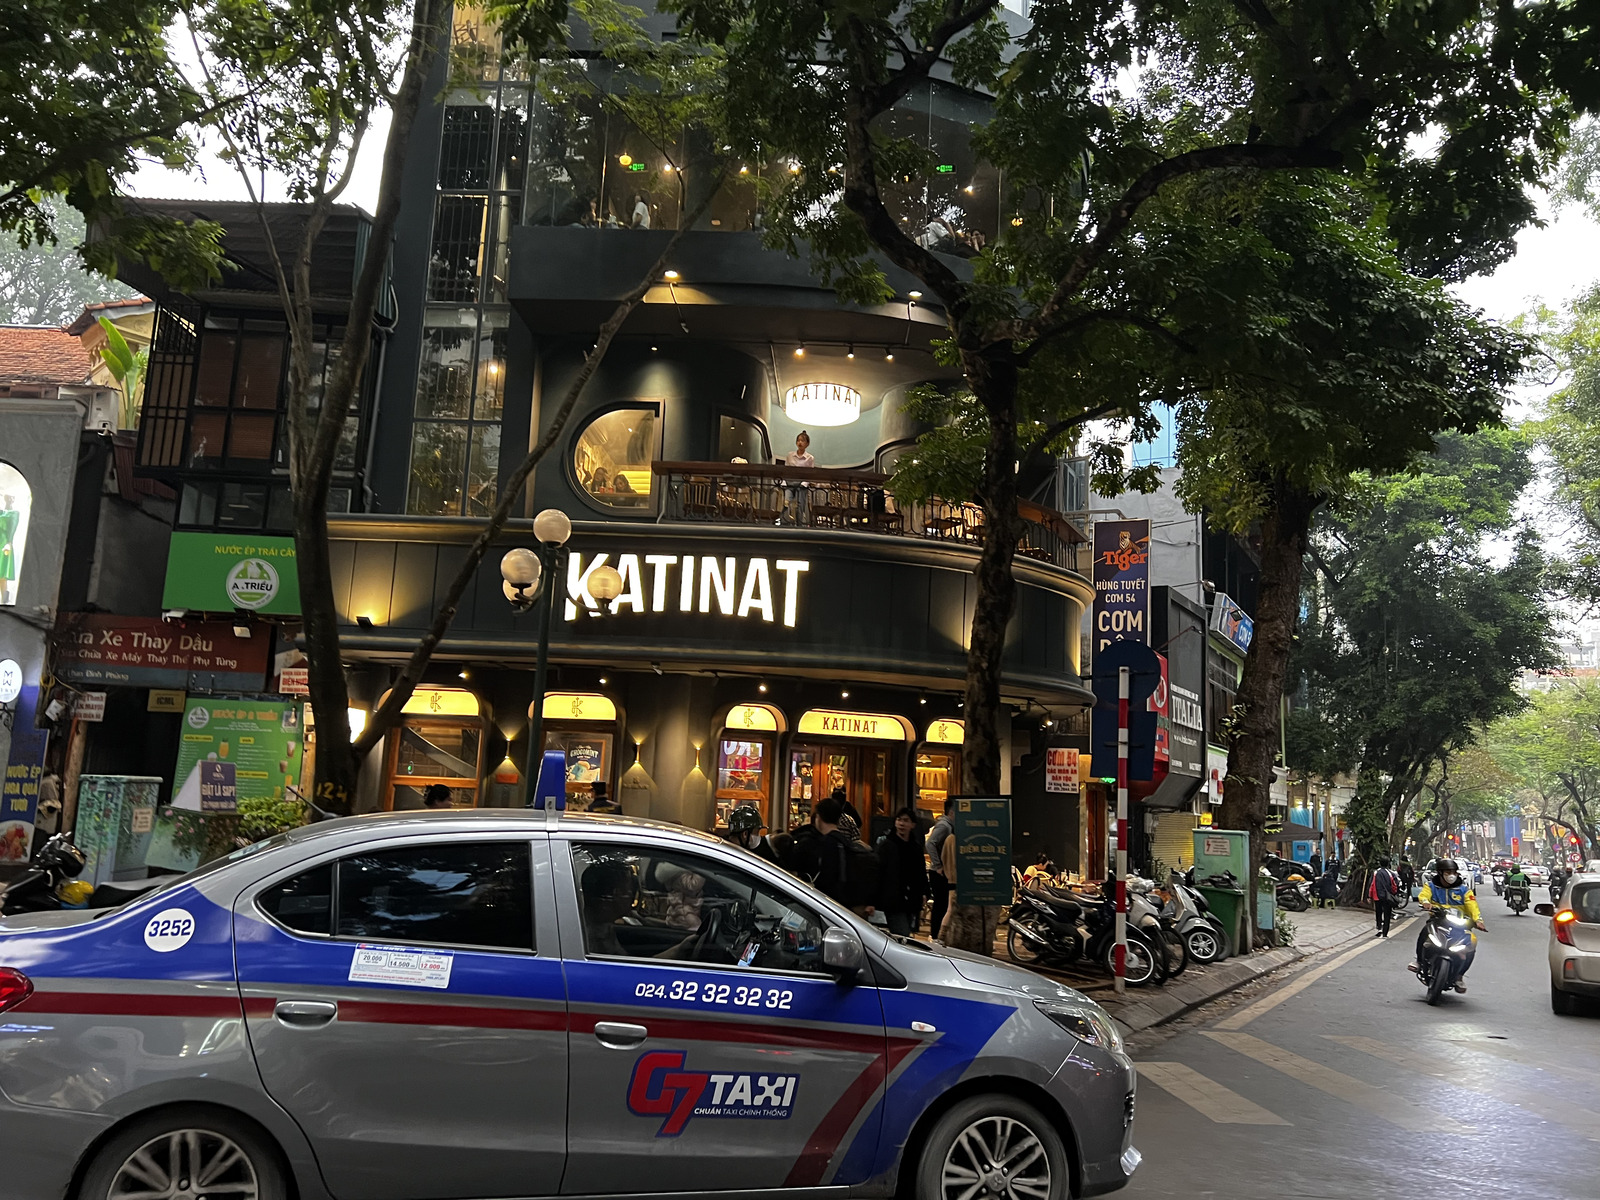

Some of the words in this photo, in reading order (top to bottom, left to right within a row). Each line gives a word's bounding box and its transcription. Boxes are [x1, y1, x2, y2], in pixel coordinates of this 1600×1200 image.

[215, 545, 242, 555] NƯỚC
[244, 545, 256, 555] ÉP
[258, 545, 278, 556] TRÁI
[1103, 549, 1148, 571] Tiger
[564, 552, 809, 628] KATINAT
[1096, 579, 1118, 591] HÙNG
[1121, 577, 1145, 590] TUYẾT
[1105, 593, 1124, 603] CƠM
[1125, 593, 1136, 603] 54
[1098, 609, 1142, 632] CƠM
[99, 629, 123, 646] Xe
[130, 631, 173, 654] Thay
[179, 632, 213, 652] Dầu
[106, 650, 118, 661] Xe
[147, 653, 168, 665] Thay
[215, 656, 238, 669] Tùng
[1171, 695, 1203, 732] ITALIA
[822, 716, 878, 734] KATINAT
[1048, 750, 1064, 766] CƠM
[1067, 751, 1077, 767] 54
[149, 919, 191, 937] 3252
[701, 983, 730, 1004] 32
[733, 986, 762, 1007] 32
[765, 989, 793, 1010] 32
[629, 1052, 709, 1134] G7
[710, 1074, 797, 1107] TAXI
